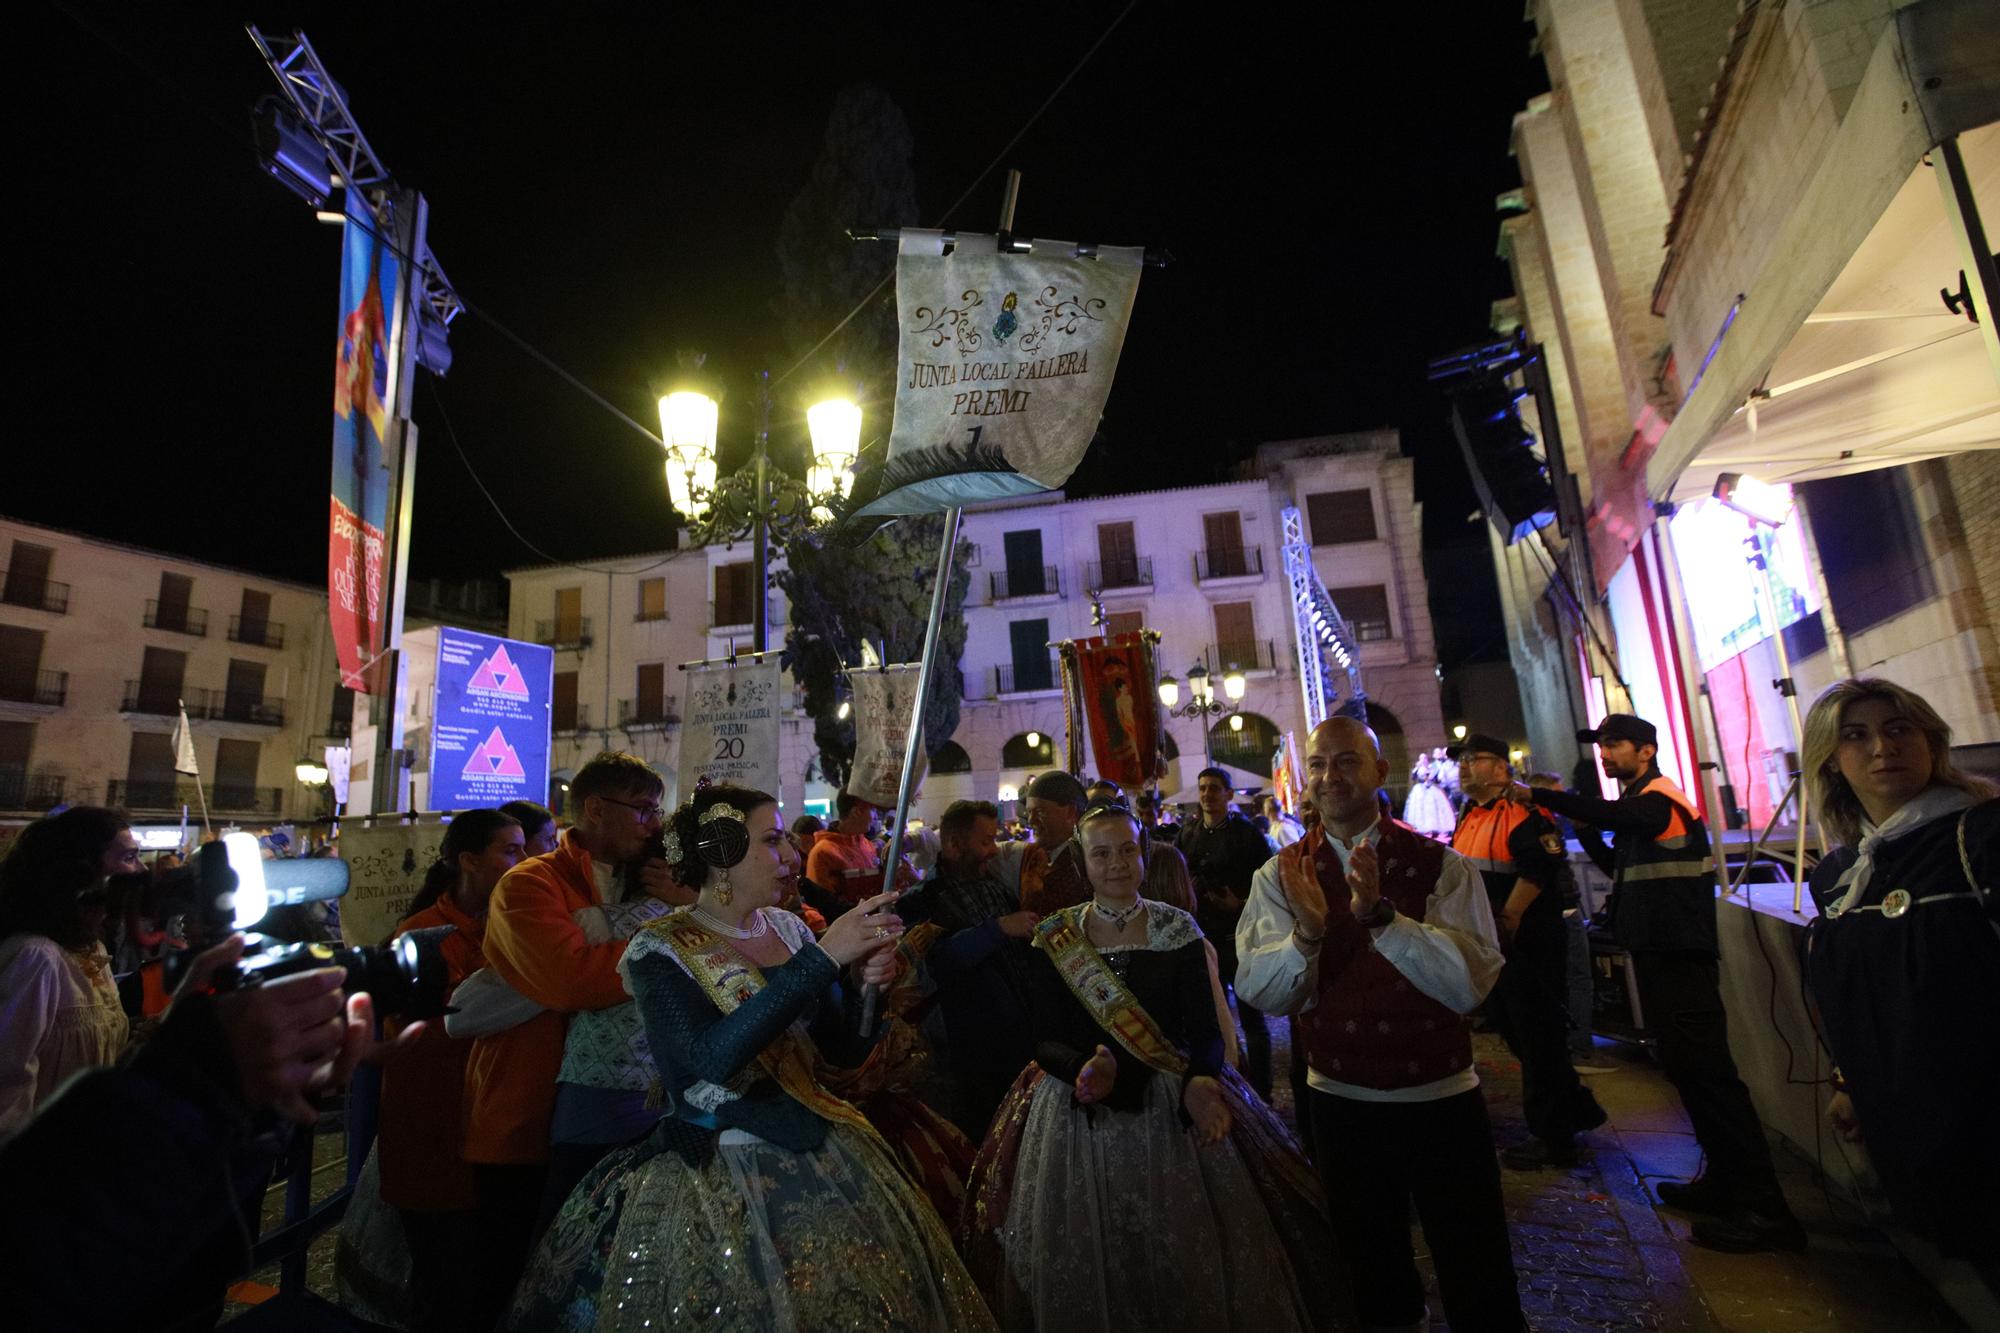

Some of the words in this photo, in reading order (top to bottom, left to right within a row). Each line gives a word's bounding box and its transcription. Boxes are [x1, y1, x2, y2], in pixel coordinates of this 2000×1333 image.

[909, 362, 956, 390] JUNTA
[960, 361, 1010, 382] LOCAL
[1014, 348, 1089, 381] FALLERA
[950, 389, 1032, 417] PREMI
[715, 711, 737, 722] LOCAL
[739, 707, 771, 720] FALLERA
[713, 723, 748, 736] PREMI
[714, 737, 745, 760] 20
[694, 762, 724, 776] FESTIVAL
[727, 760, 760, 770] MUSICAL
[355, 886, 385, 900] JUNTA
[387, 884, 416, 895] LOCAL
[385, 898, 413, 914] PRE
